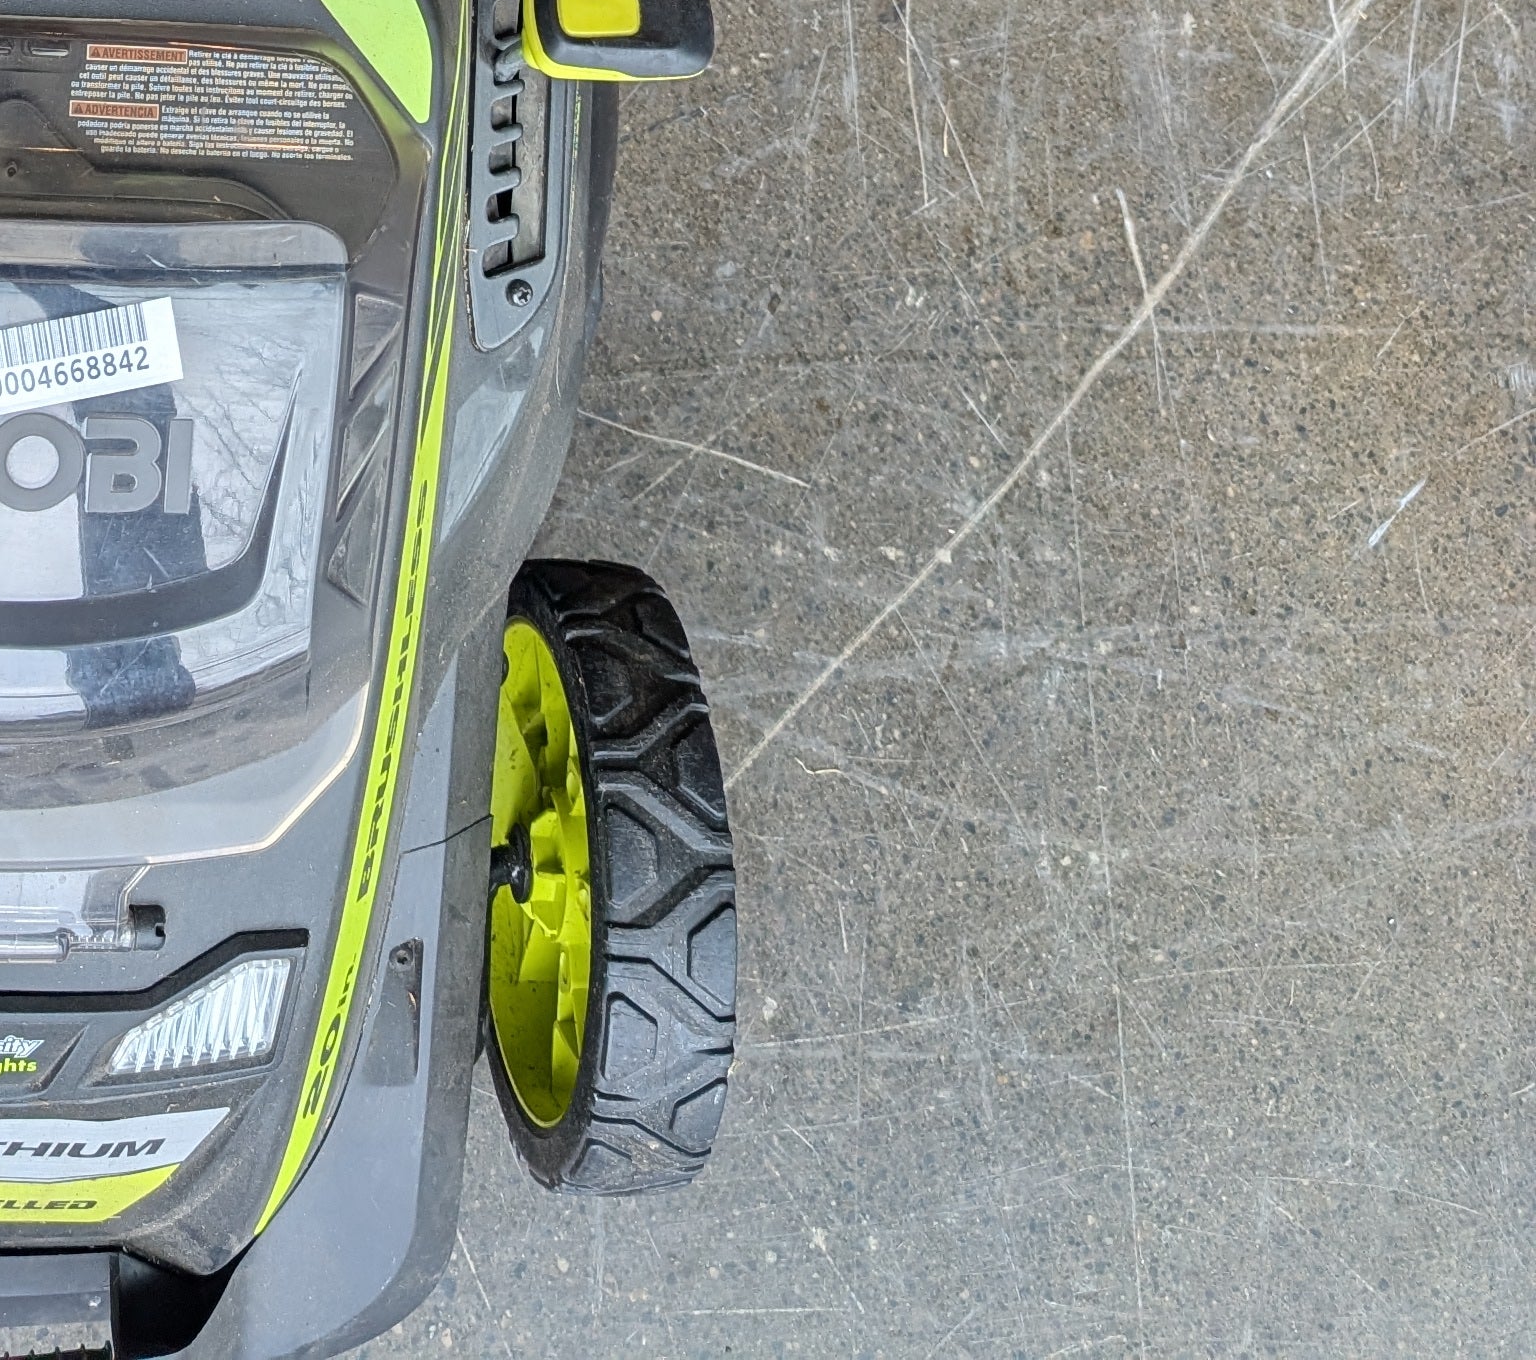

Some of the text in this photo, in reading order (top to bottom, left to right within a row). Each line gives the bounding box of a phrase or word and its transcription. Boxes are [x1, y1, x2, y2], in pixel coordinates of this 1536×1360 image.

[101, 47, 184, 61] AVERTISSEMENT
[85, 104, 154, 117] ADVERTENCIA
[358, 482, 427, 902] BRUSHLESS
